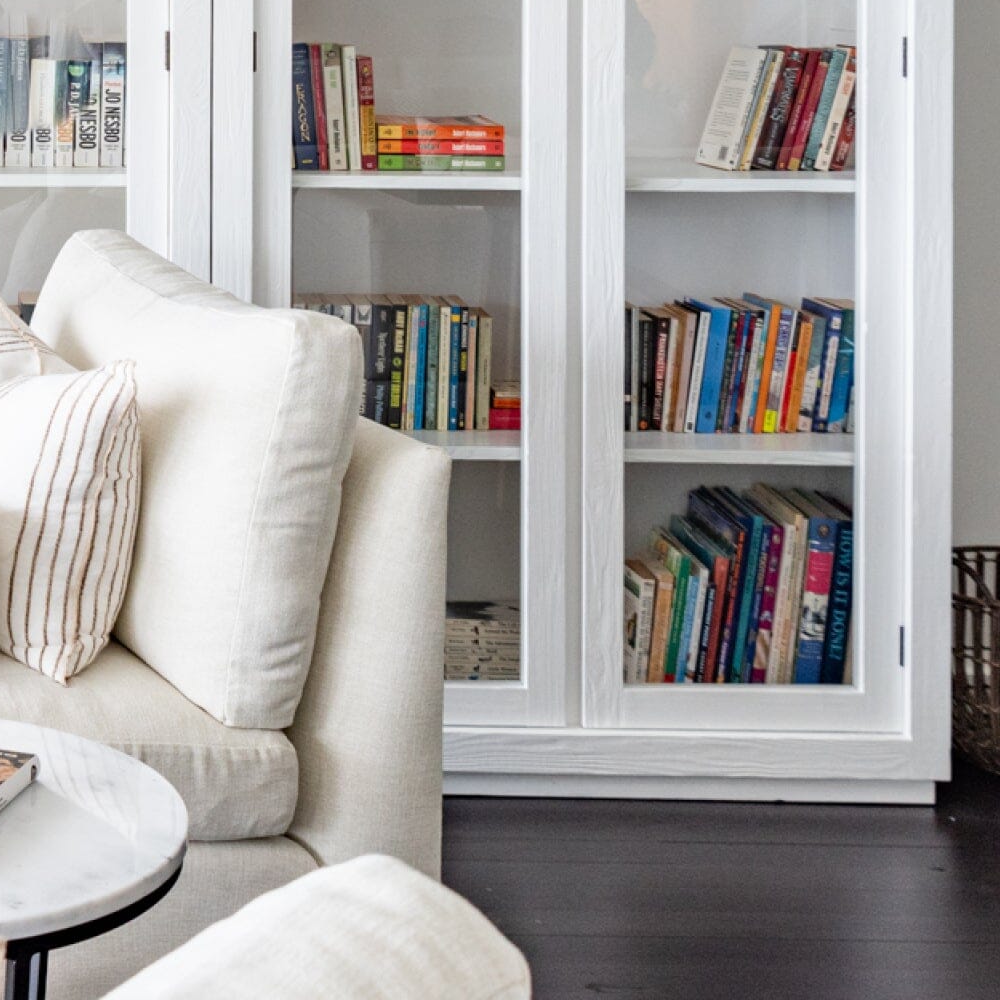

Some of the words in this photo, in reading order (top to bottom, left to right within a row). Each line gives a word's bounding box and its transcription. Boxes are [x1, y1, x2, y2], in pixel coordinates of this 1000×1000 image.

[105, 89, 121, 103] JO
[840, 530, 853, 566] HOW
[837, 572, 850, 585] IS
[835, 590, 848, 604] IT
